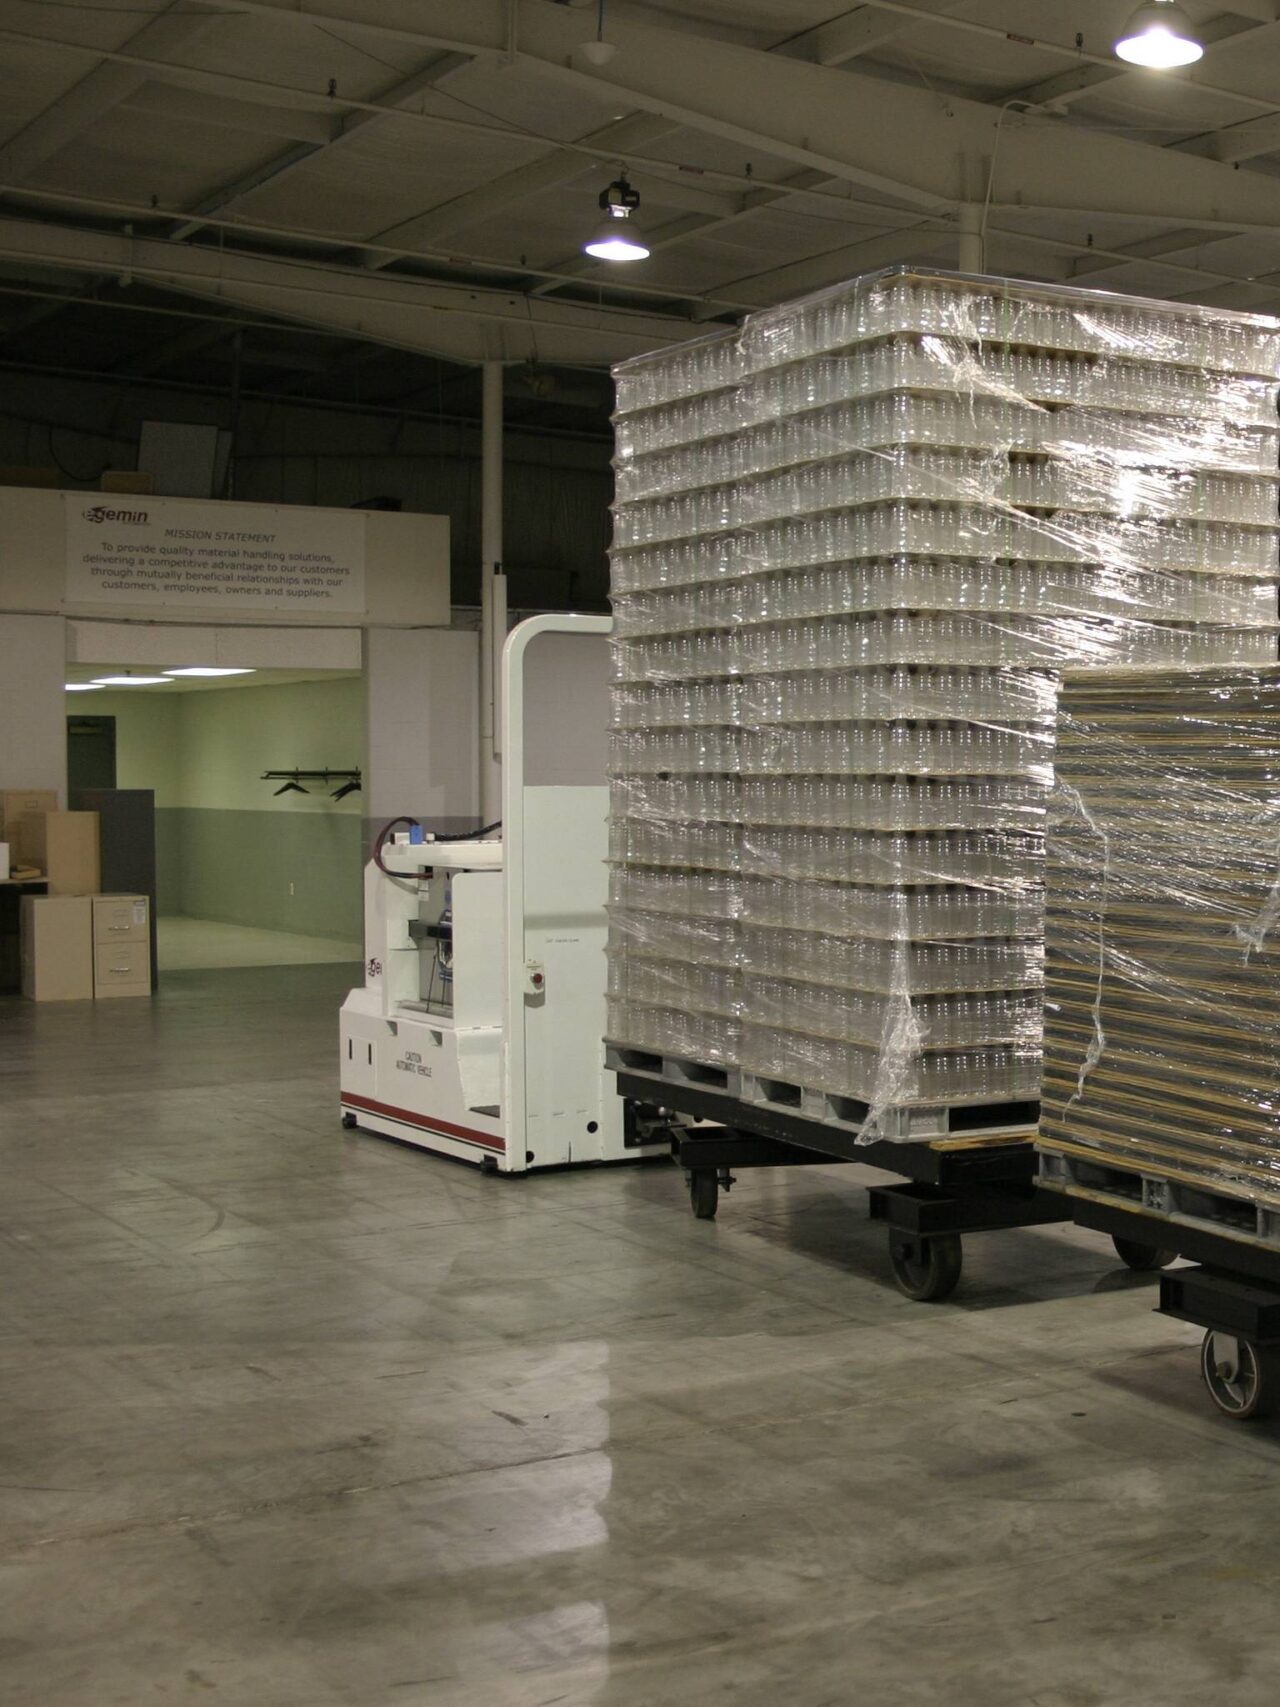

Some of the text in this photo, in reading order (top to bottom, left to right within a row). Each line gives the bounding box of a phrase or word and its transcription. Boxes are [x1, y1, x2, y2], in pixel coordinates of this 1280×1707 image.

[165, 529, 276, 543] MISSION STATEMENT
[101, 542, 113, 551] To
[117, 544, 156, 554] provide
[159, 545, 193, 556] quality
[198, 548, 240, 558] material
[243, 550, 285, 562] handling
[83, 554, 135, 567] delivering
[148, 557, 209, 569] competitive
[212, 560, 265, 573] advantage
[267, 562, 277, 571] to
[280, 564, 296, 572] our
[300, 564, 350, 575] customers
[90, 567, 343, 586] through mutually beneficial relationships with our
[102, 580, 160, 592] customers,
[164, 582, 222, 594] employees,
[226, 586, 261, 595] owners
[264, 585, 283, 596] and
[405, 1051, 422, 1063] CAUTION
[396, 1059, 416, 1073] AUTOMATIC
